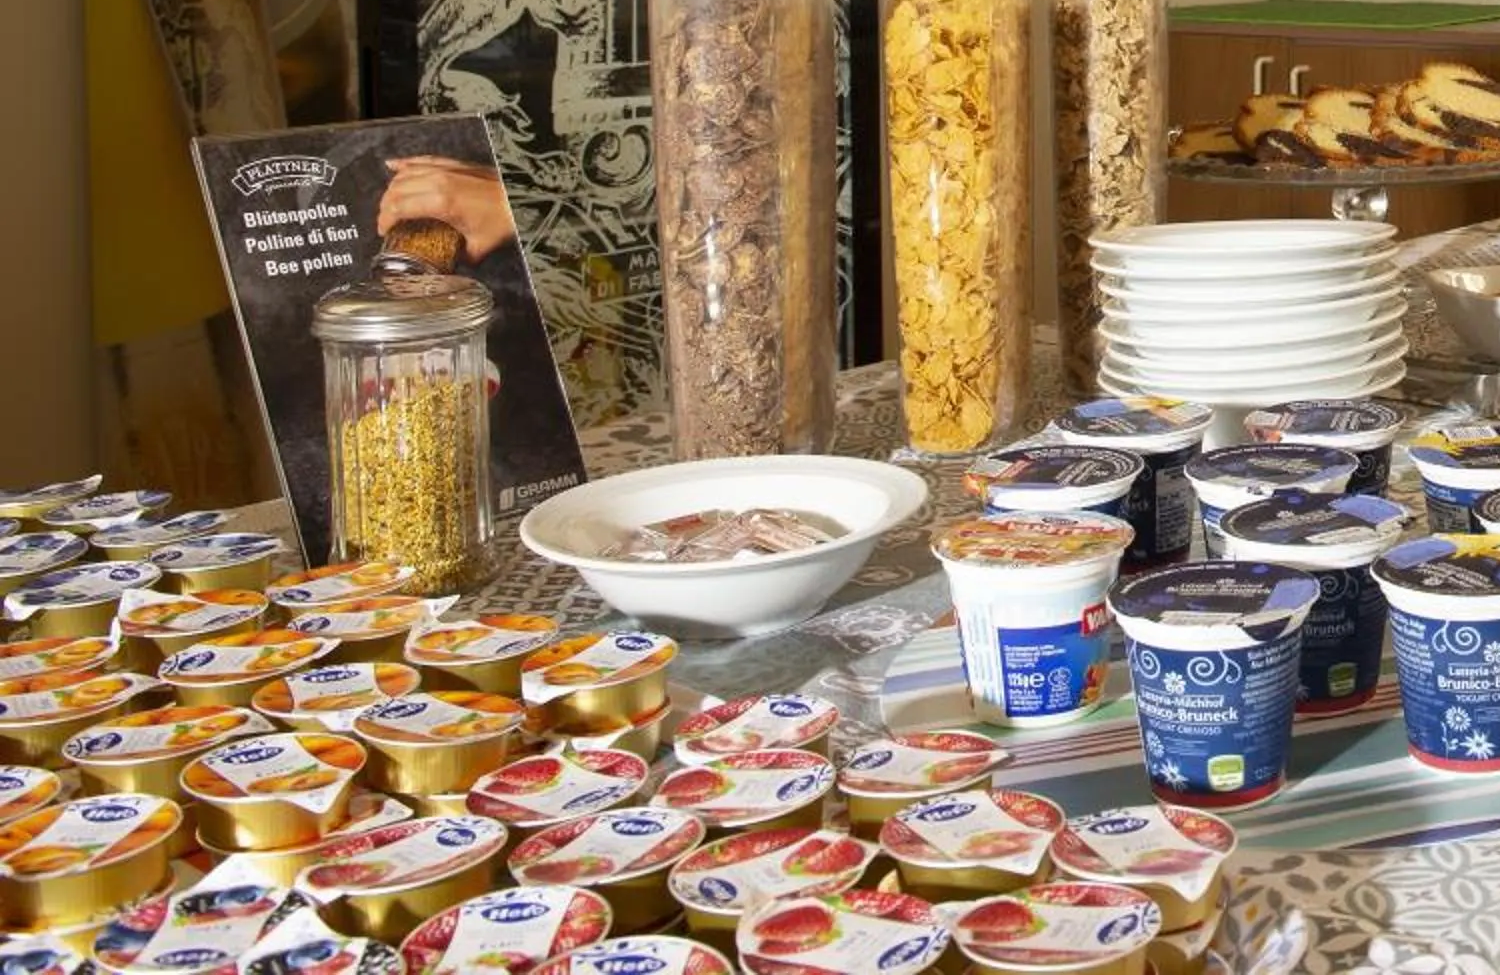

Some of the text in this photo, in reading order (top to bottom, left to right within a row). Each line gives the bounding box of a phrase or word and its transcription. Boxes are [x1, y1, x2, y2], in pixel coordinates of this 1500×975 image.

[246, 161, 322, 181] PLATTNER
[243, 203, 348, 228] Blütenpollen
[245, 224, 359, 253] Polline di fiori
[265, 252, 353, 276] Bee pollen
[90, 807, 135, 821] Hero
[616, 820, 661, 835] Hero
[490, 905, 546, 921] Hero
[605, 958, 661, 973] Hero
